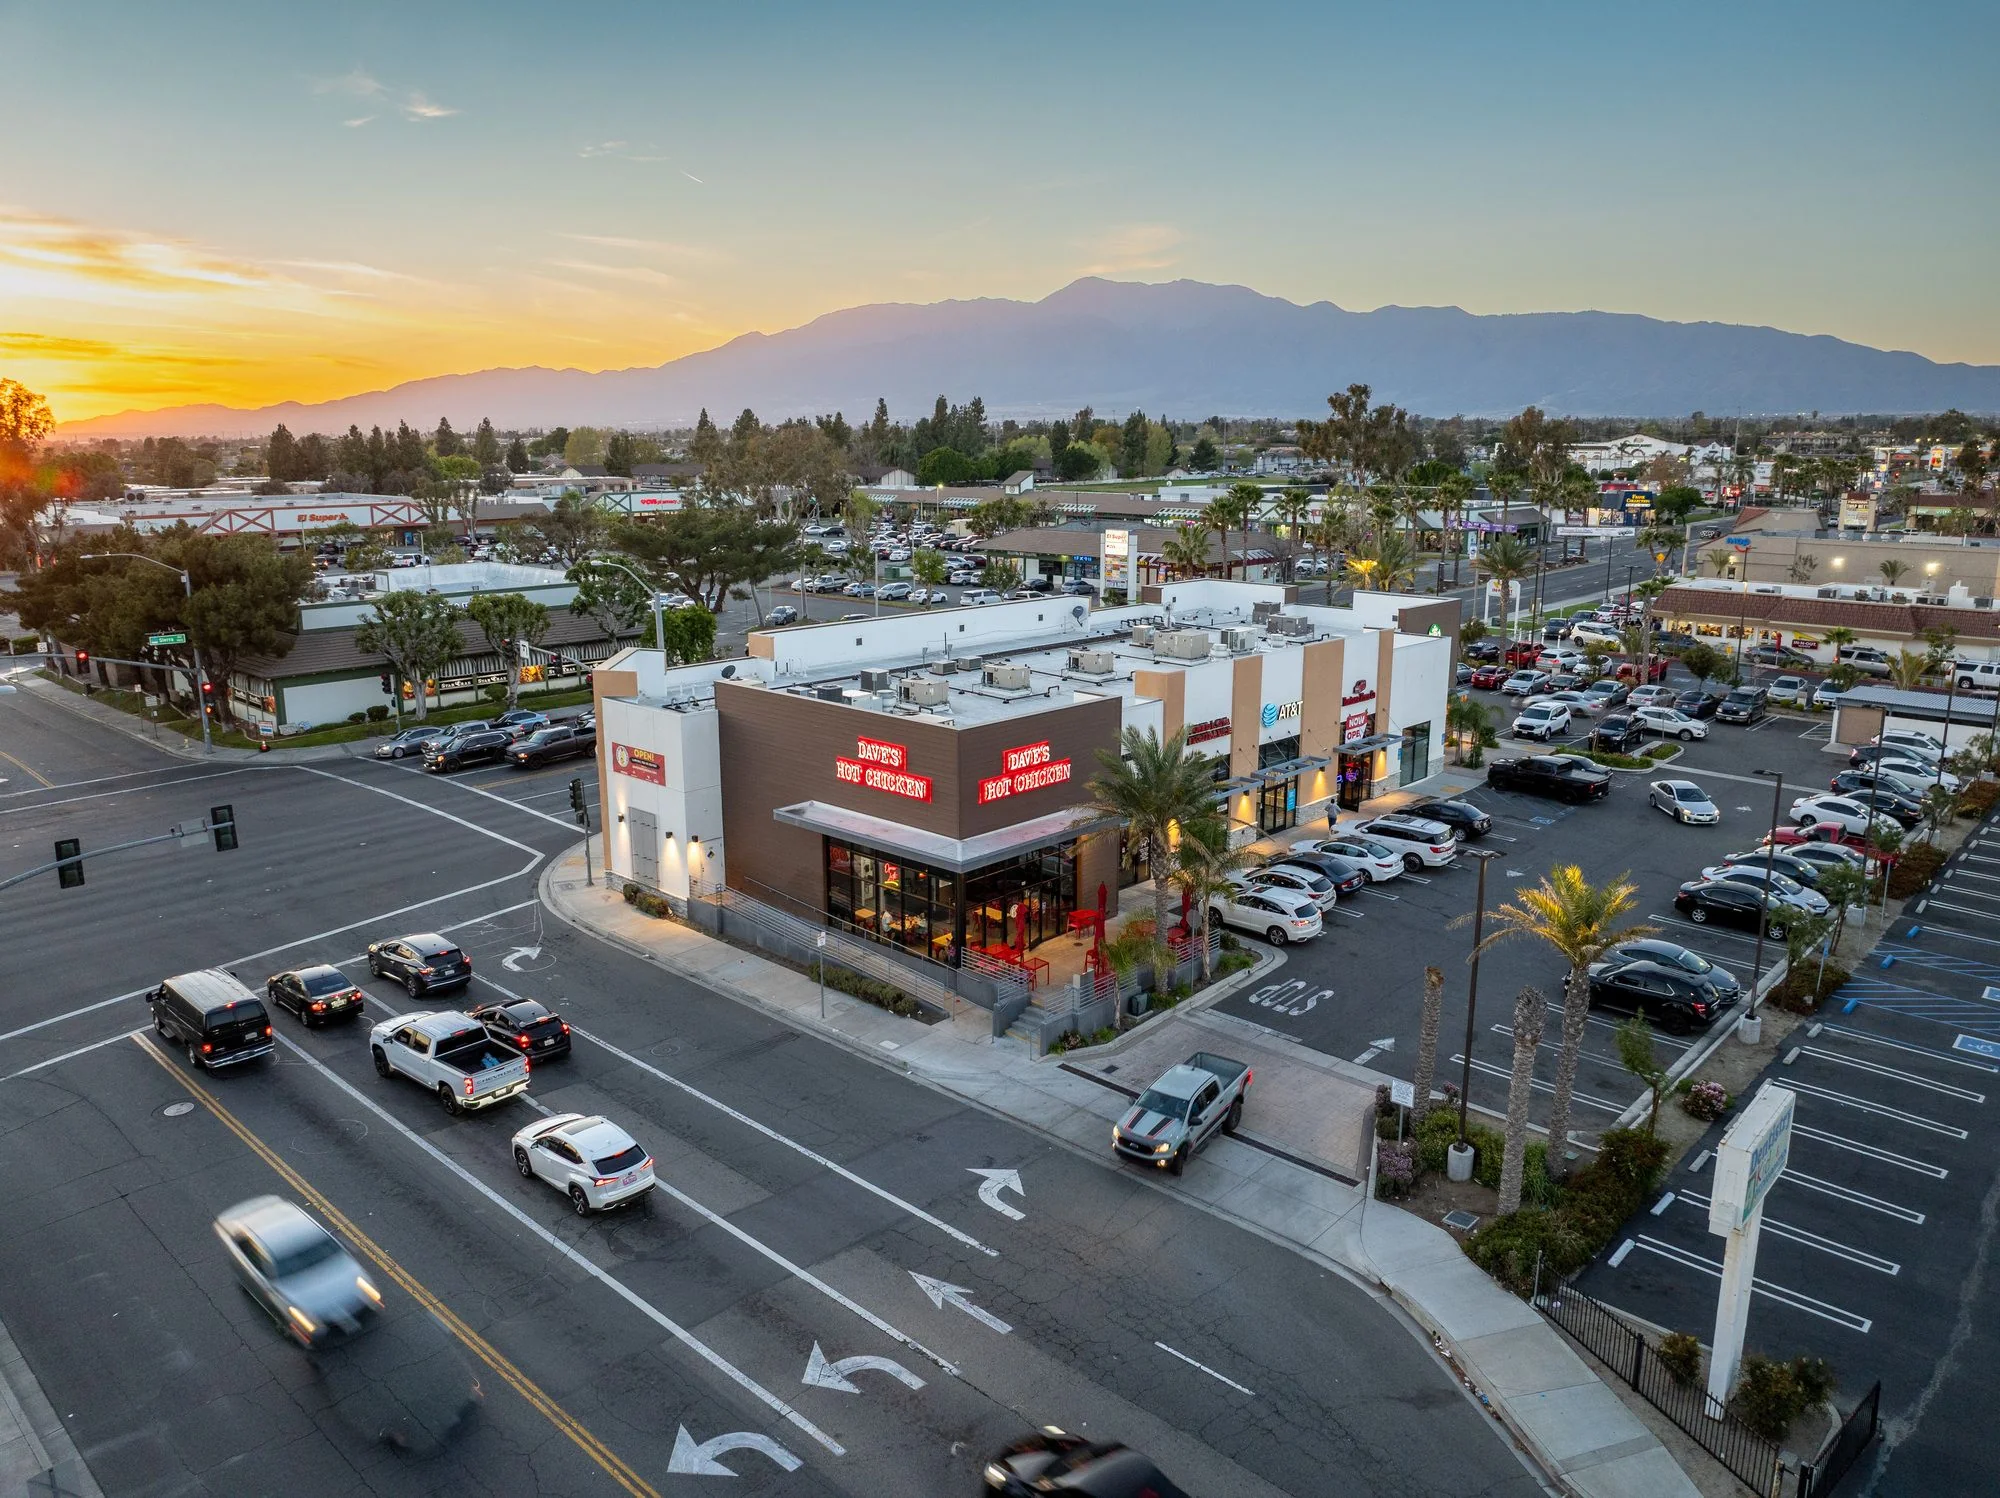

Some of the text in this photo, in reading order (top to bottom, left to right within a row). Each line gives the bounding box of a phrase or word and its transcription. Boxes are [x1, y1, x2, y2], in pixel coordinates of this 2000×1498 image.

[308, 513, 338, 523] Super
[1278, 701, 1304, 720] AT&T
[1348, 715, 1365, 728] NOW
[1347, 730, 1361, 740] OPE
[633, 748, 655, 761] OPEN!
[857, 741, 901, 767] DAVE'S
[1008, 745, 1050, 771] DAVE'S
[836, 761, 925, 799] HOT CHICKEN
[985, 763, 1071, 800] HOT CHICKEN
